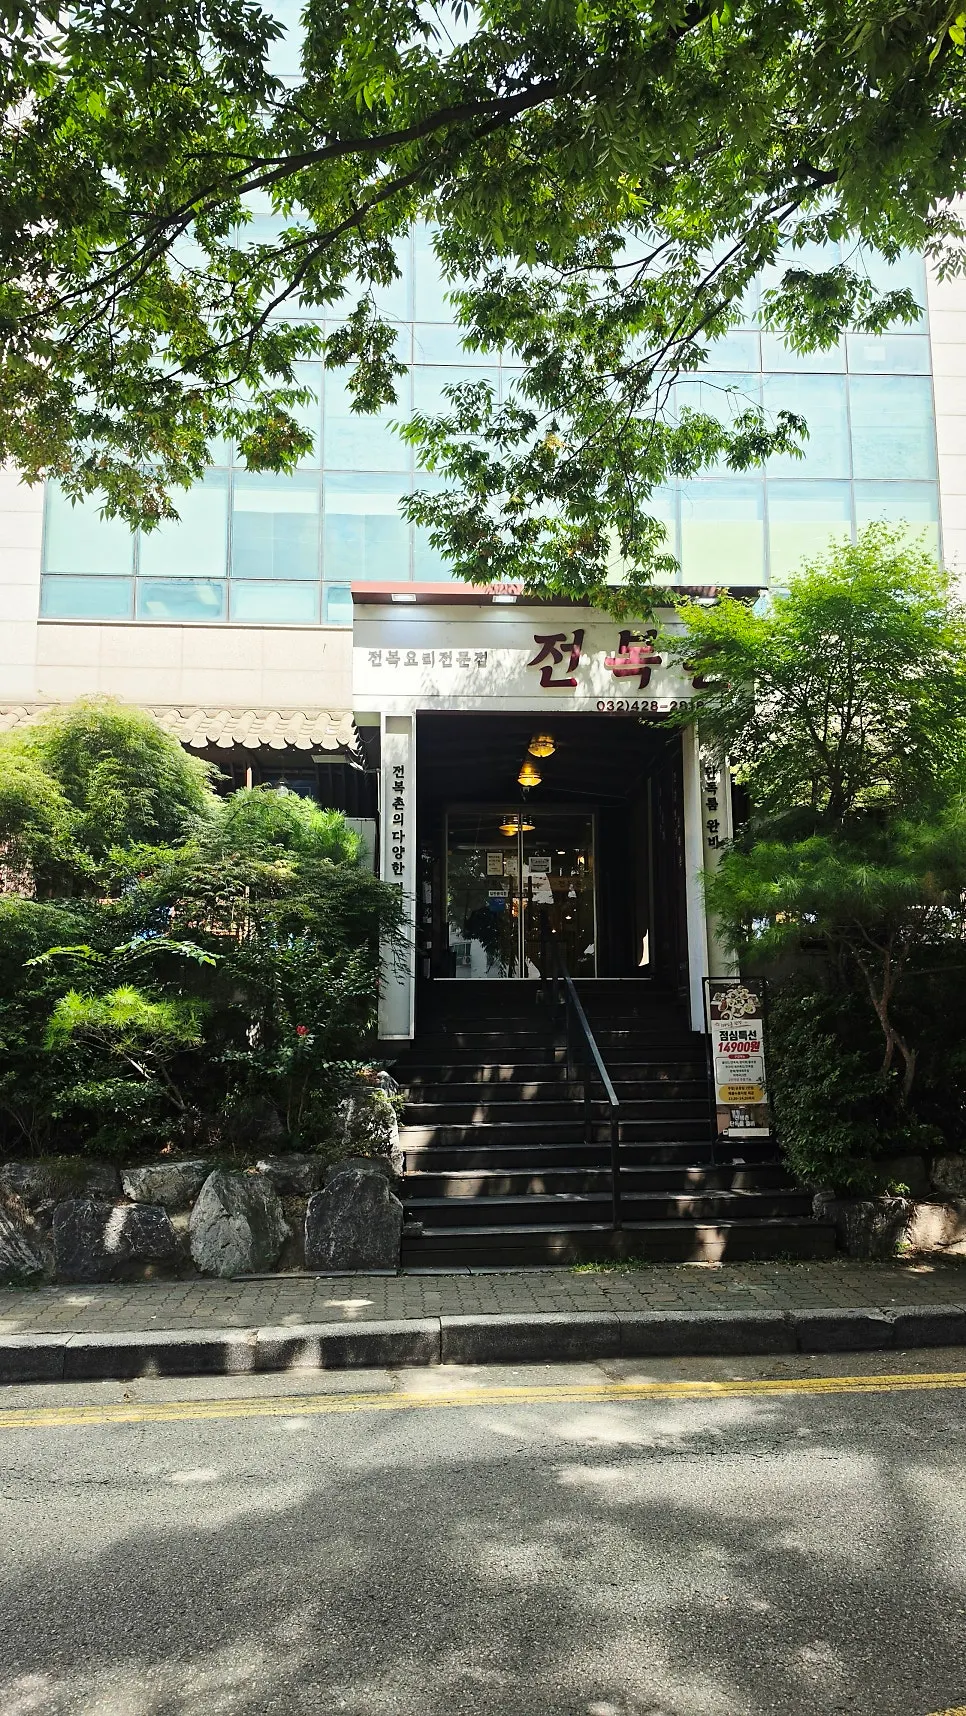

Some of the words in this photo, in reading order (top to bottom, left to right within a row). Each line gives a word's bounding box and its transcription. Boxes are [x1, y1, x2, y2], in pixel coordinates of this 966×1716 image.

[706, 818, 720, 850] 완비
[719, 1030, 757, 1041] 점심특선
[718, 1040, 760, 1052] 14900원
